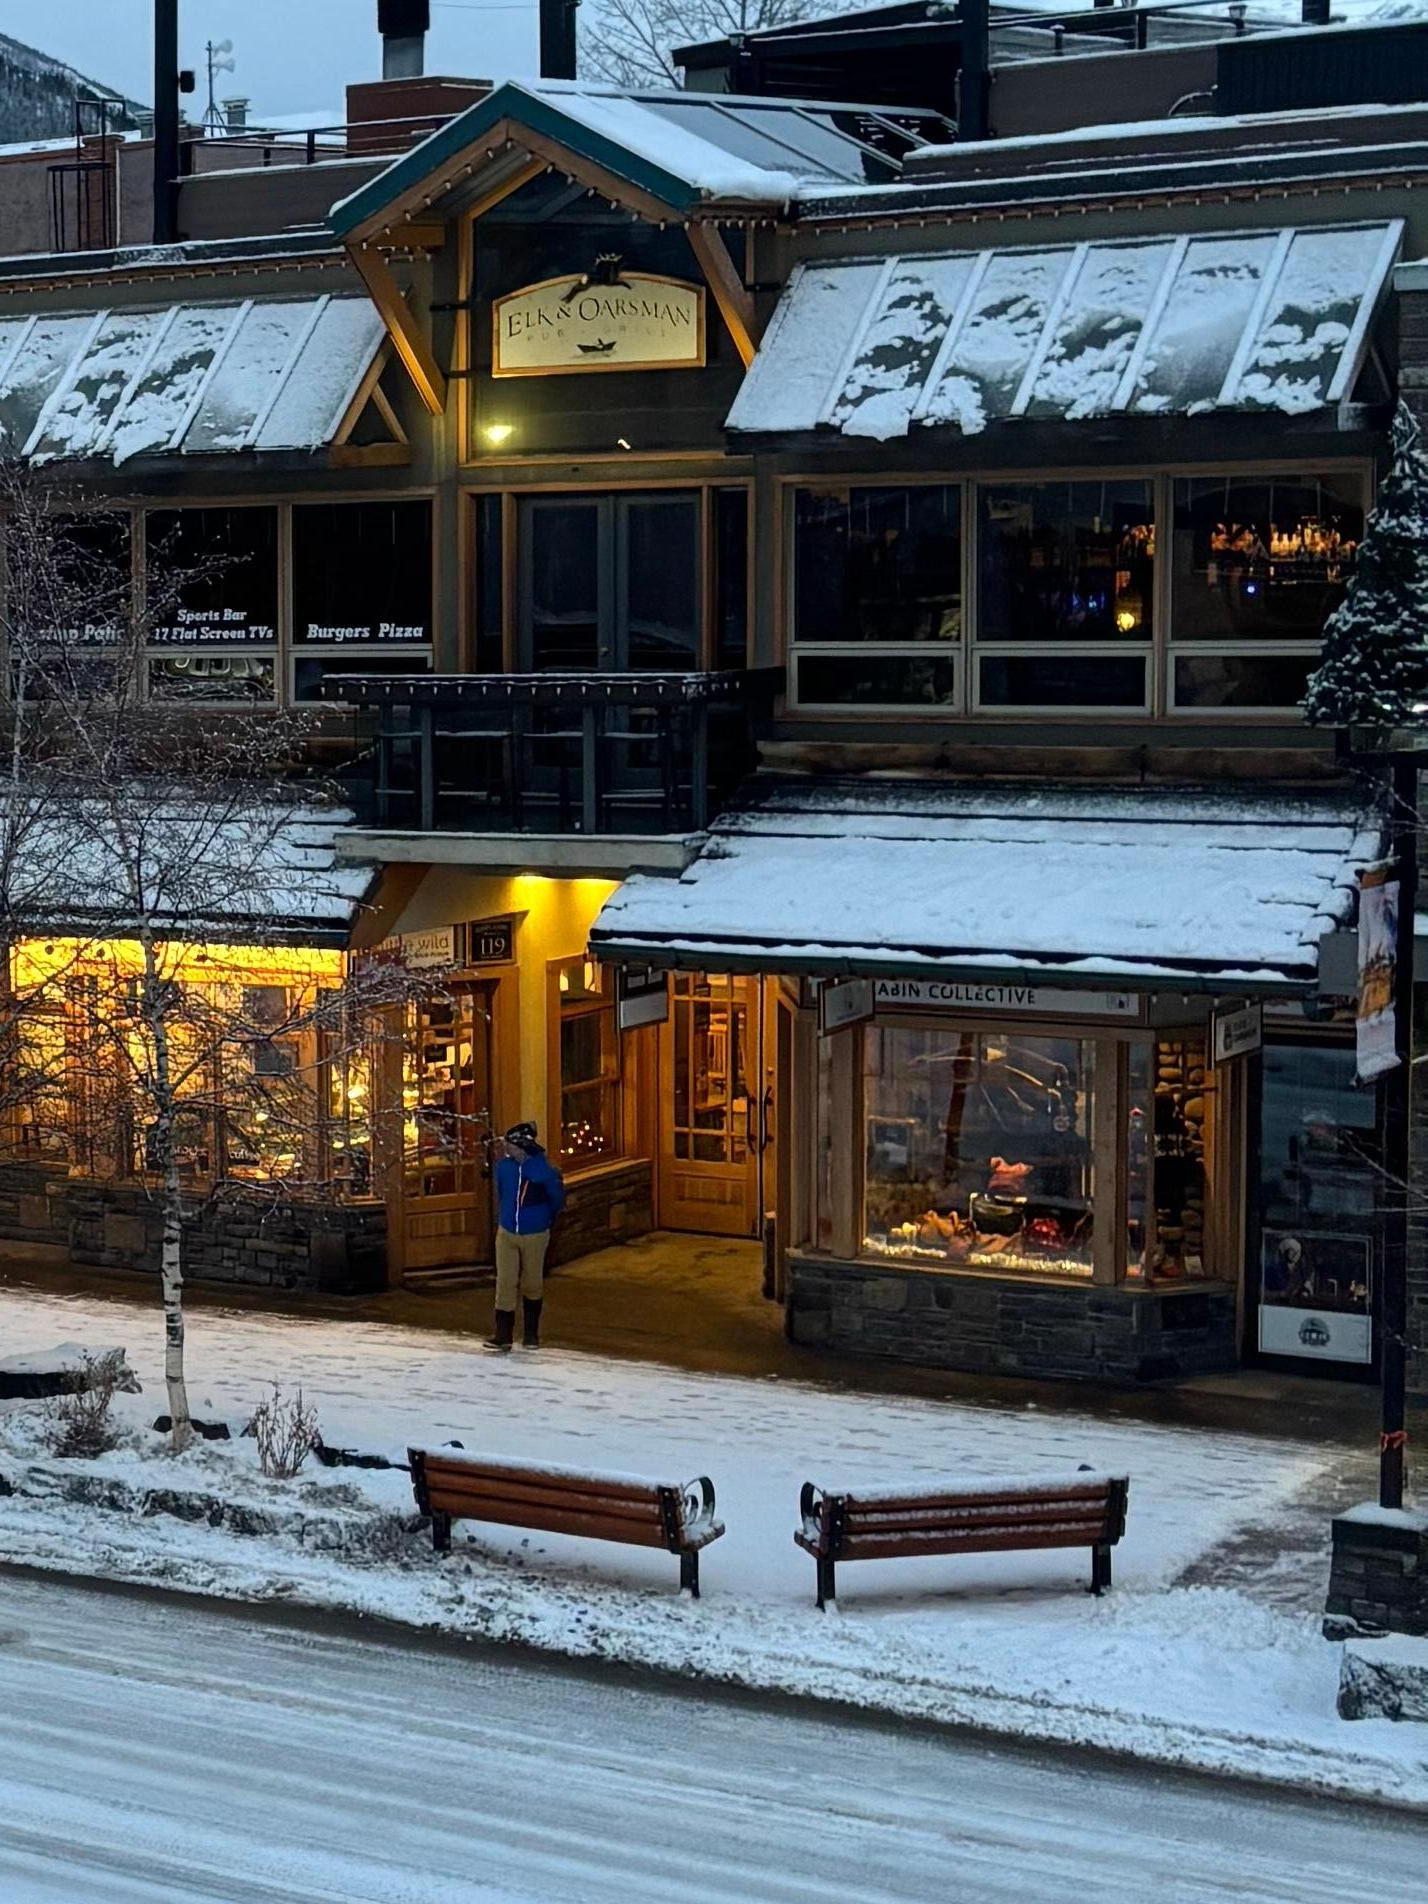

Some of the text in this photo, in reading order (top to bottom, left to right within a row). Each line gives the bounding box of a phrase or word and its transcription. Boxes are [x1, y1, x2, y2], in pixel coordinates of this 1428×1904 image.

[508, 297, 691, 338] ELK & OARSMAN
[177, 608, 248, 622] Sports Bar
[154, 625, 274, 641] 17 Flat Screen TVs
[306, 622, 424, 642] Burgers Pizza
[480, 937, 506, 956] 119
[877, 982, 1036, 1005] ABIN COLLECTIVE
